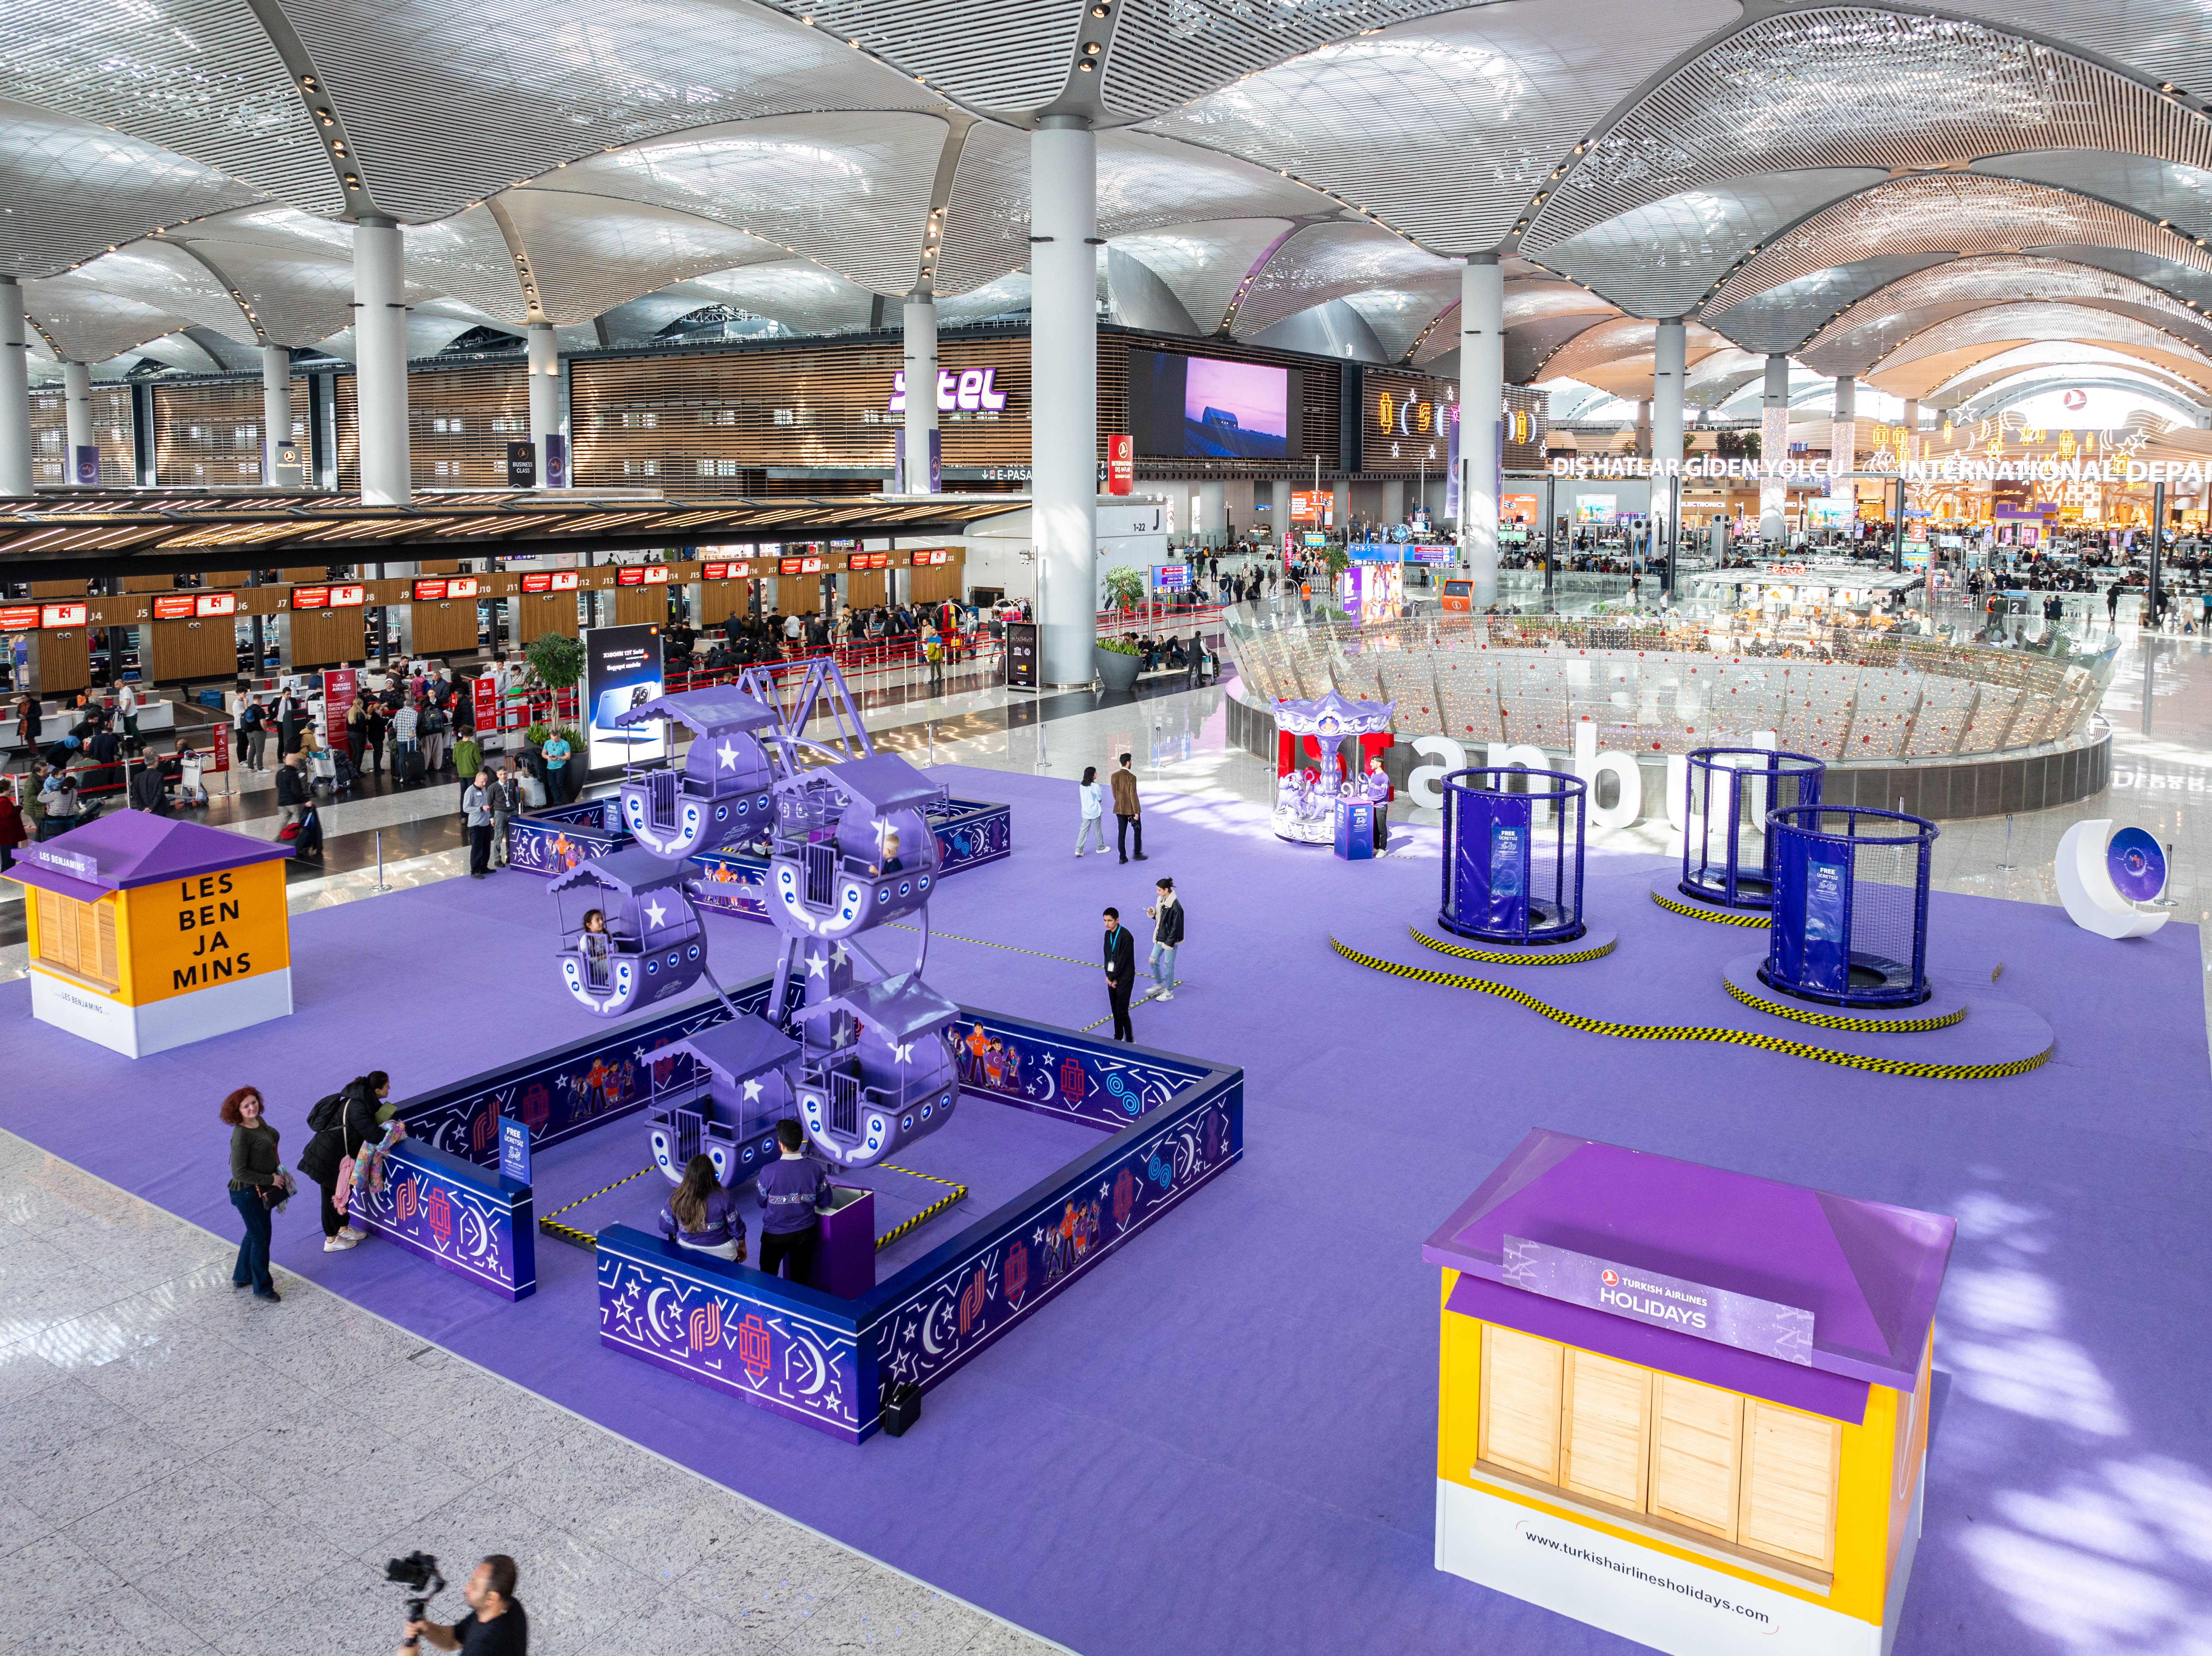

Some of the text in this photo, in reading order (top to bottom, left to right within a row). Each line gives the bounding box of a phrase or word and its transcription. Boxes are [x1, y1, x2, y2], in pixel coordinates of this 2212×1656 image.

[1553, 454, 1844, 480] DIŞ HATLAR GİDEN YOLCU
[1900, 459, 2119, 482] INTERNATIONAL
[1133, 523, 1145, 532] 1-22
[1153, 509, 1160, 531] J
[1914, 529, 1922, 538] 2
[277, 599, 287, 607] J7
[400, 591, 410, 599] J9
[137, 609, 148, 618] J5
[237, 602, 248, 611] J6
[90, 612, 102, 621] J4
[39, 851, 85, 872] LES BENJAMINS
[181, 873, 233, 902] LES
[1818, 882, 1836, 890] 2-10
[179, 899, 240, 932] BEN
[192, 931, 230, 956] JA
[173, 952, 251, 990] MINS
[504, 1134, 524, 1148] ÜCRETSİZ
[506, 1127, 521, 1139] FREE
[508, 1149, 521, 1161] 2-5
[1622, 1277, 1707, 1307] TURKISH AIRLINES
[1600, 1287, 1706, 1329] HOLIDAYS
[1525, 1530, 1769, 1624] www.turkishairlinesholidays.com
